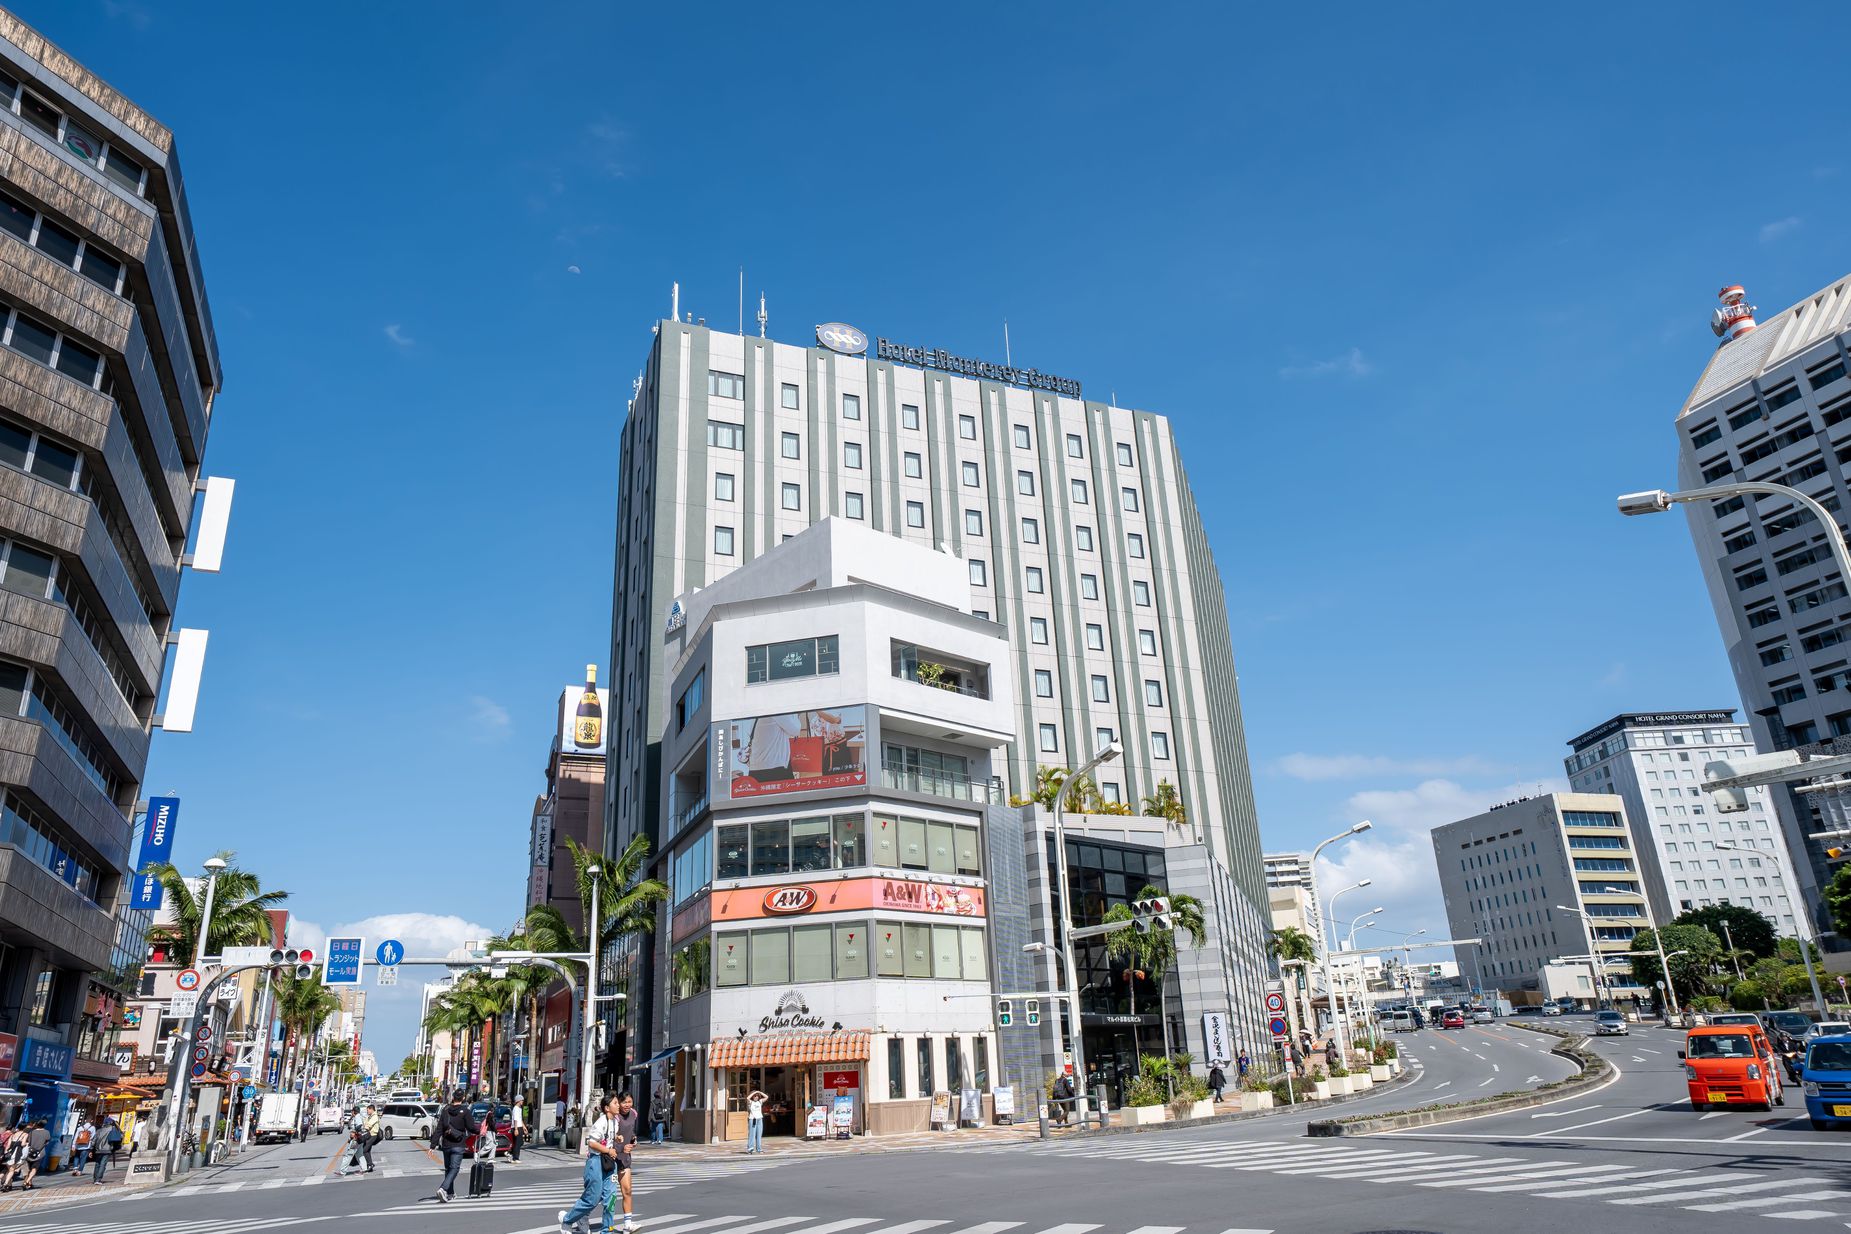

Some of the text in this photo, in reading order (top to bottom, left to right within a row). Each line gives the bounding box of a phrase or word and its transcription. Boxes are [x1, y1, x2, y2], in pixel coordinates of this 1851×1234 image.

[876, 336, 1083, 398] Hotel Monterey Group
[153, 804, 170, 846] MIZUHO
[774, 890, 807, 908] A&W
[884, 881, 923, 903] A&W
[332, 942, 359, 951] 日曜日
[329, 954, 359, 963] トランジット
[1269, 998, 1280, 1007] 40
[758, 1013, 825, 1033] Shisa Cookie
